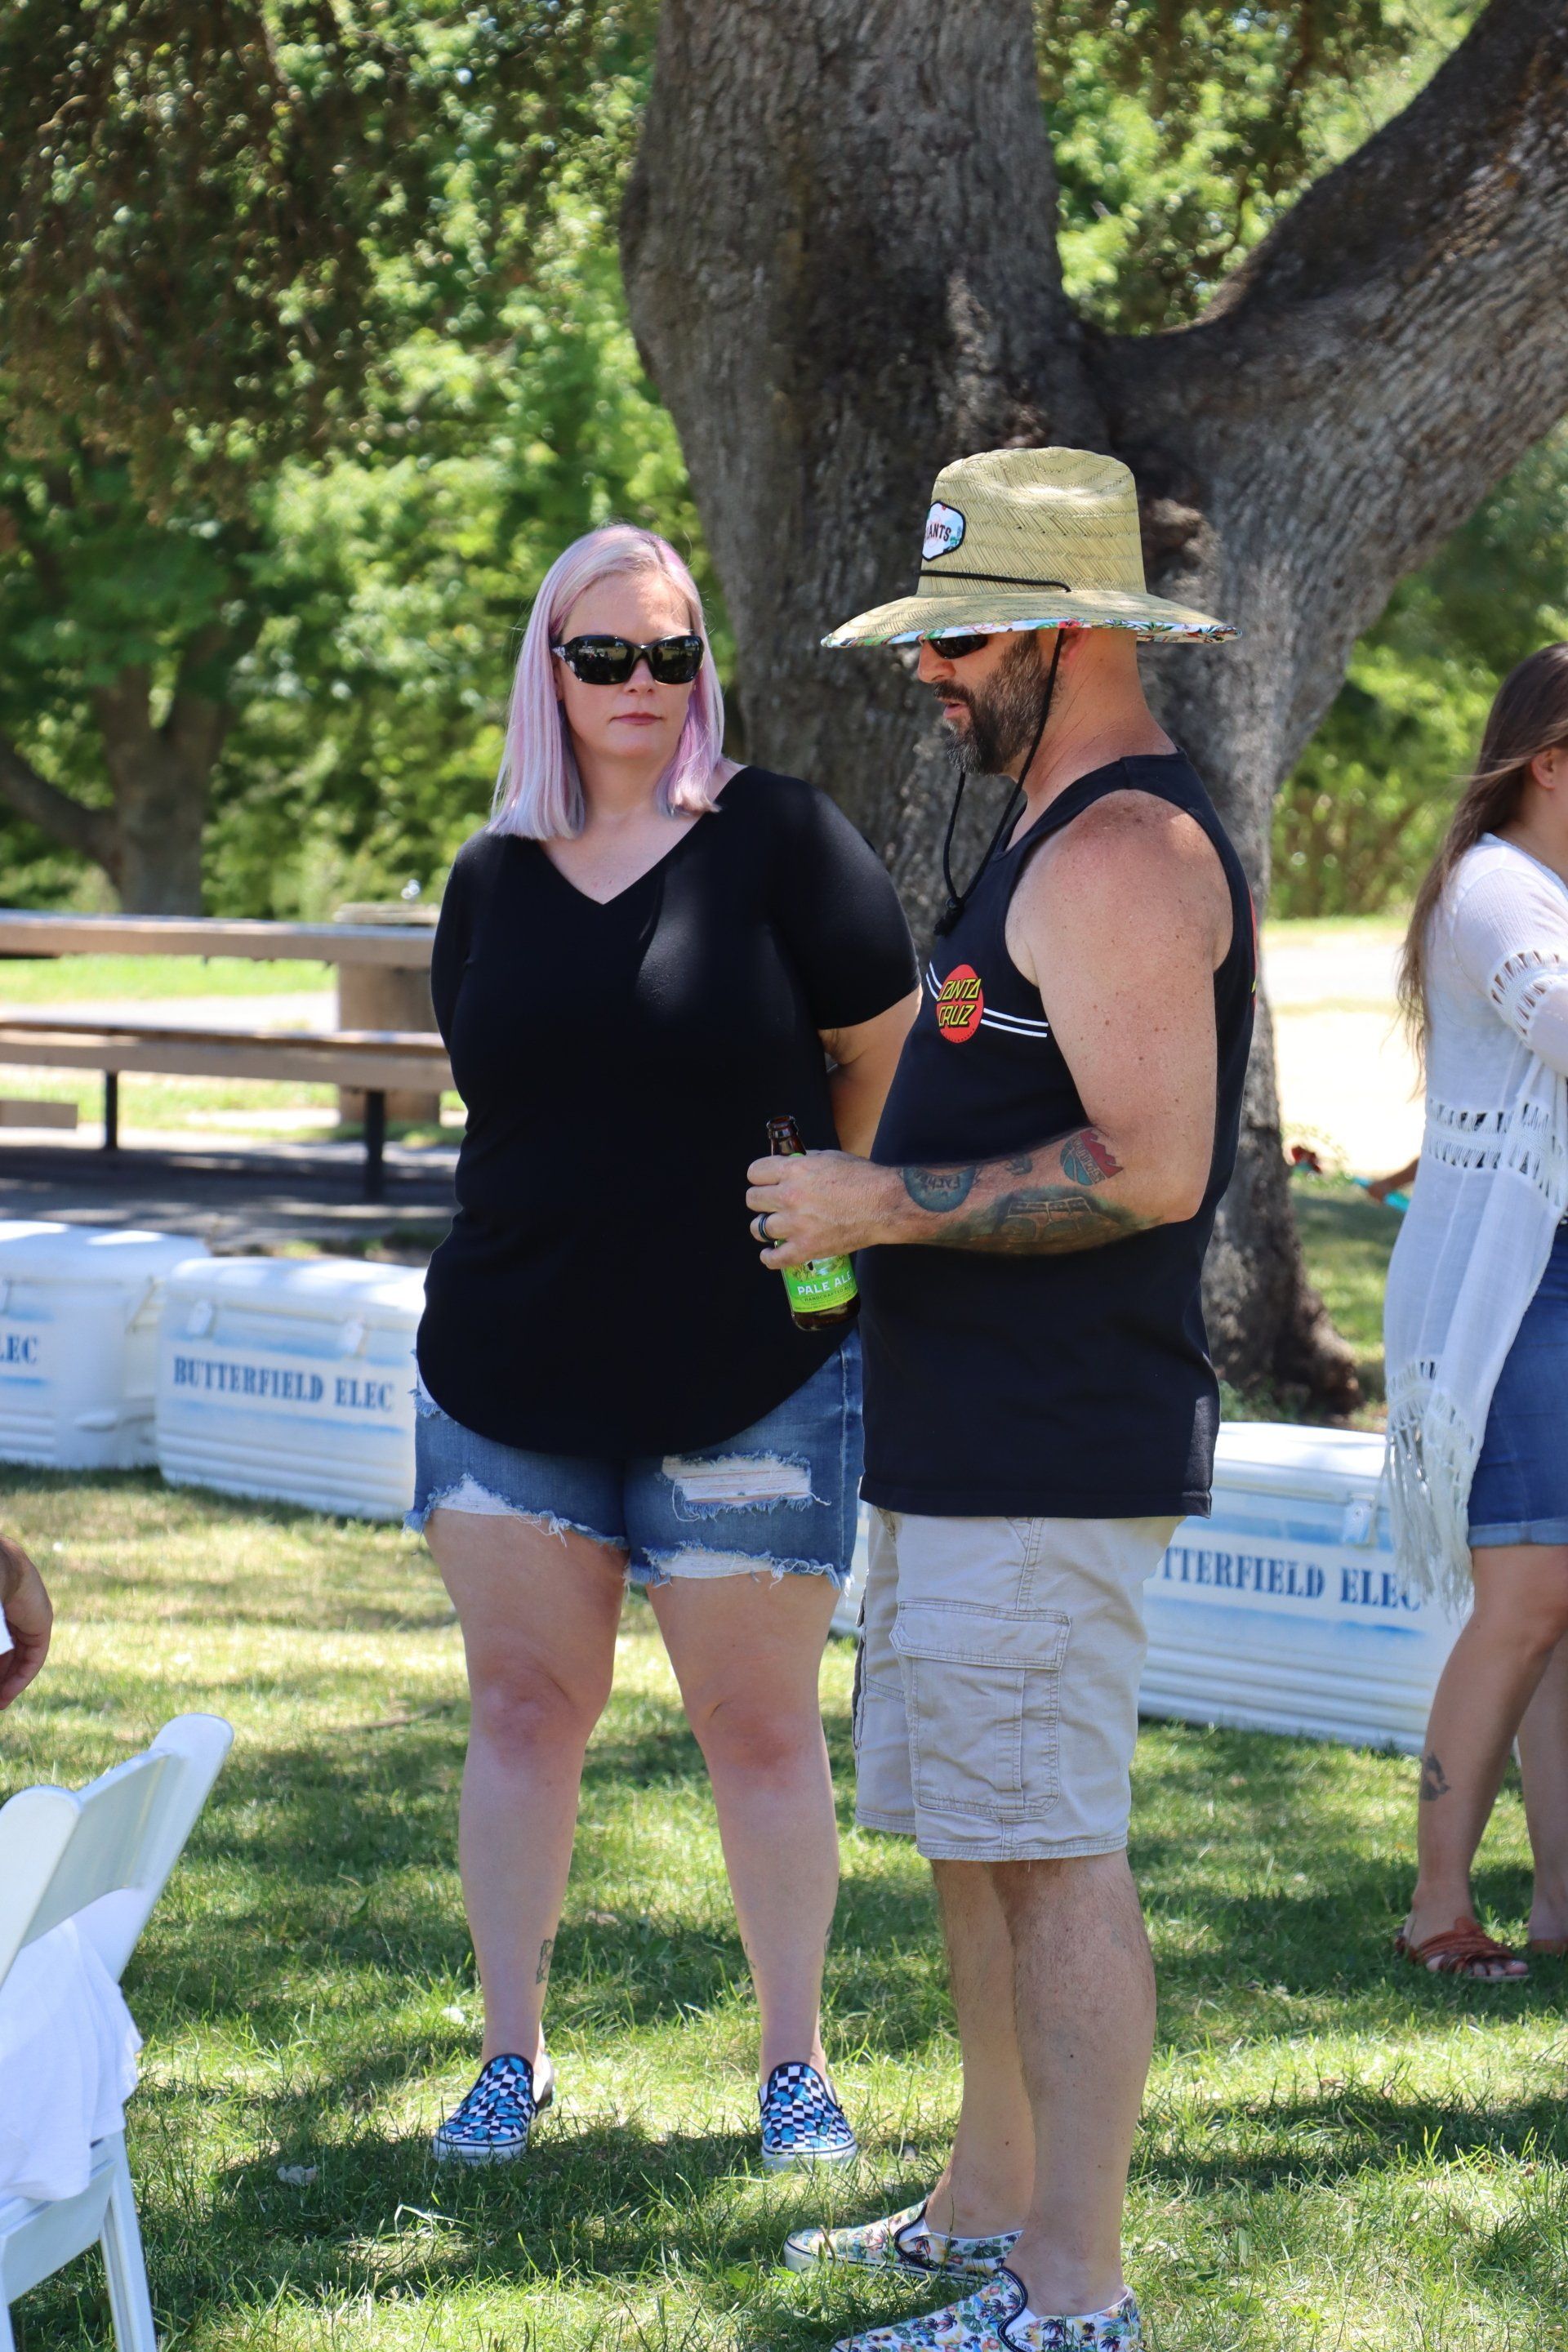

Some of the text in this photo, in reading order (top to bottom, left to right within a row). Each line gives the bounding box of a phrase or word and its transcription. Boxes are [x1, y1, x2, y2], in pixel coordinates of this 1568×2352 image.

[937, 978, 982, 1002] SANTA
[938, 1004, 976, 1027] CRUZ
[797, 1271, 852, 1295] PALE ALE
[174, 1356, 393, 1412] BUTTERFIELD ELEC
[1148, 1547, 1325, 1599] TTERFIELD
